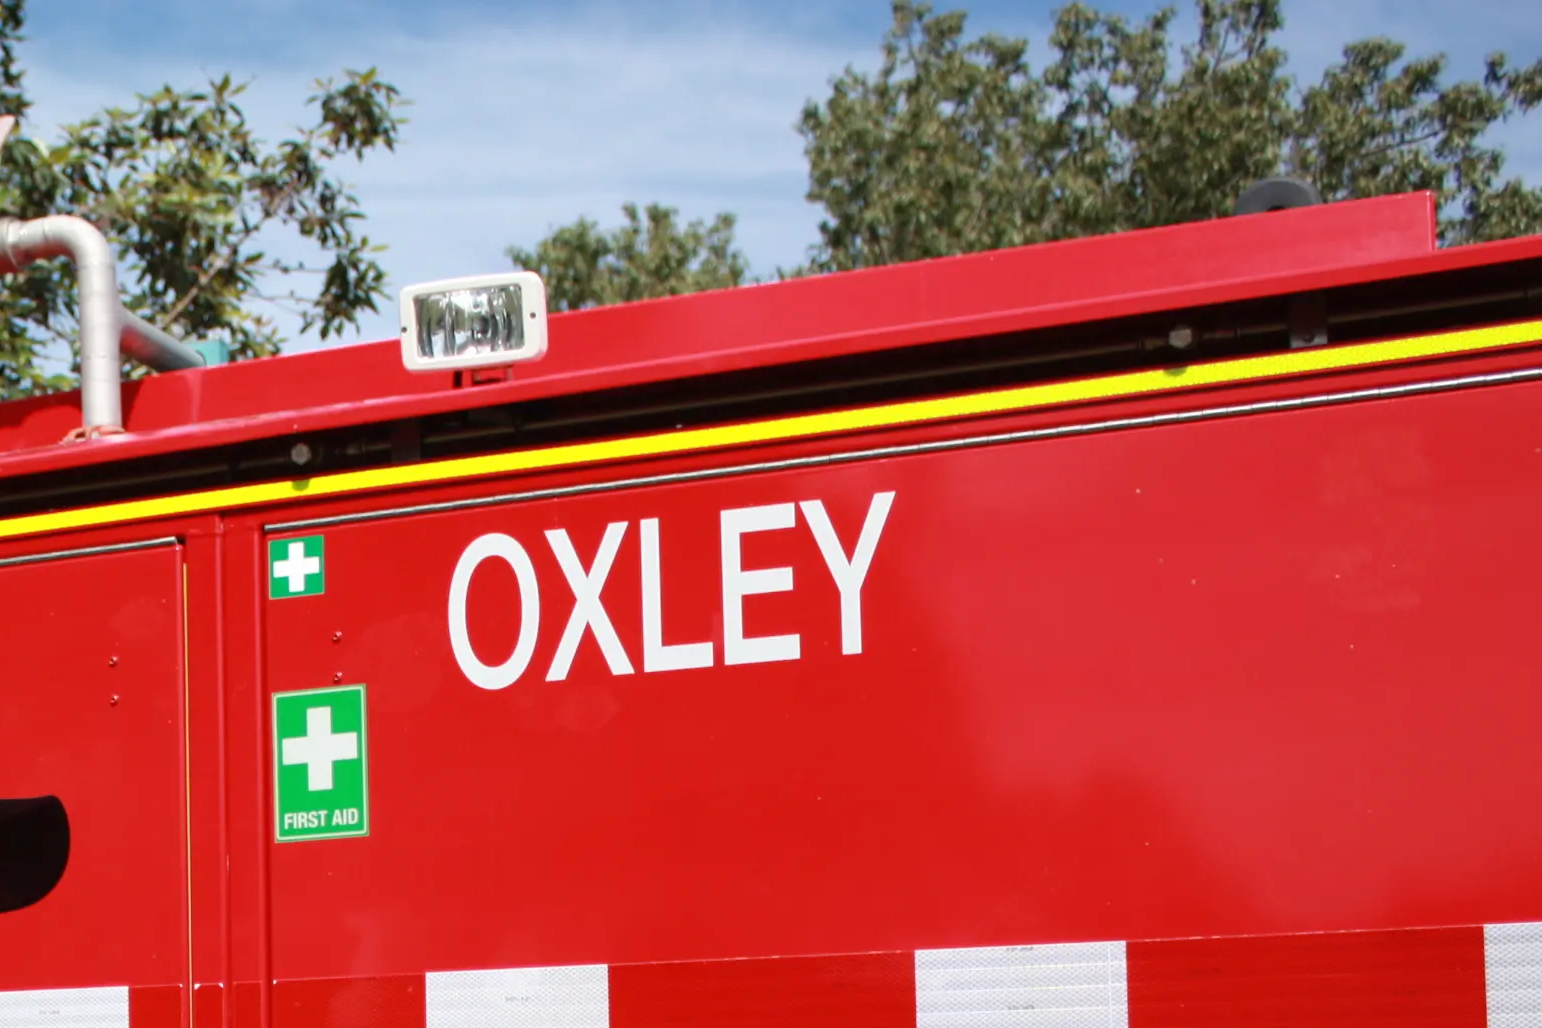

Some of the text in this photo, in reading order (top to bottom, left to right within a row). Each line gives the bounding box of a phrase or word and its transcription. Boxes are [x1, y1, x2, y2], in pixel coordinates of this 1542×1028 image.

[448, 492, 896, 690] OXLEY
[284, 808, 359, 830] FIRST AID
